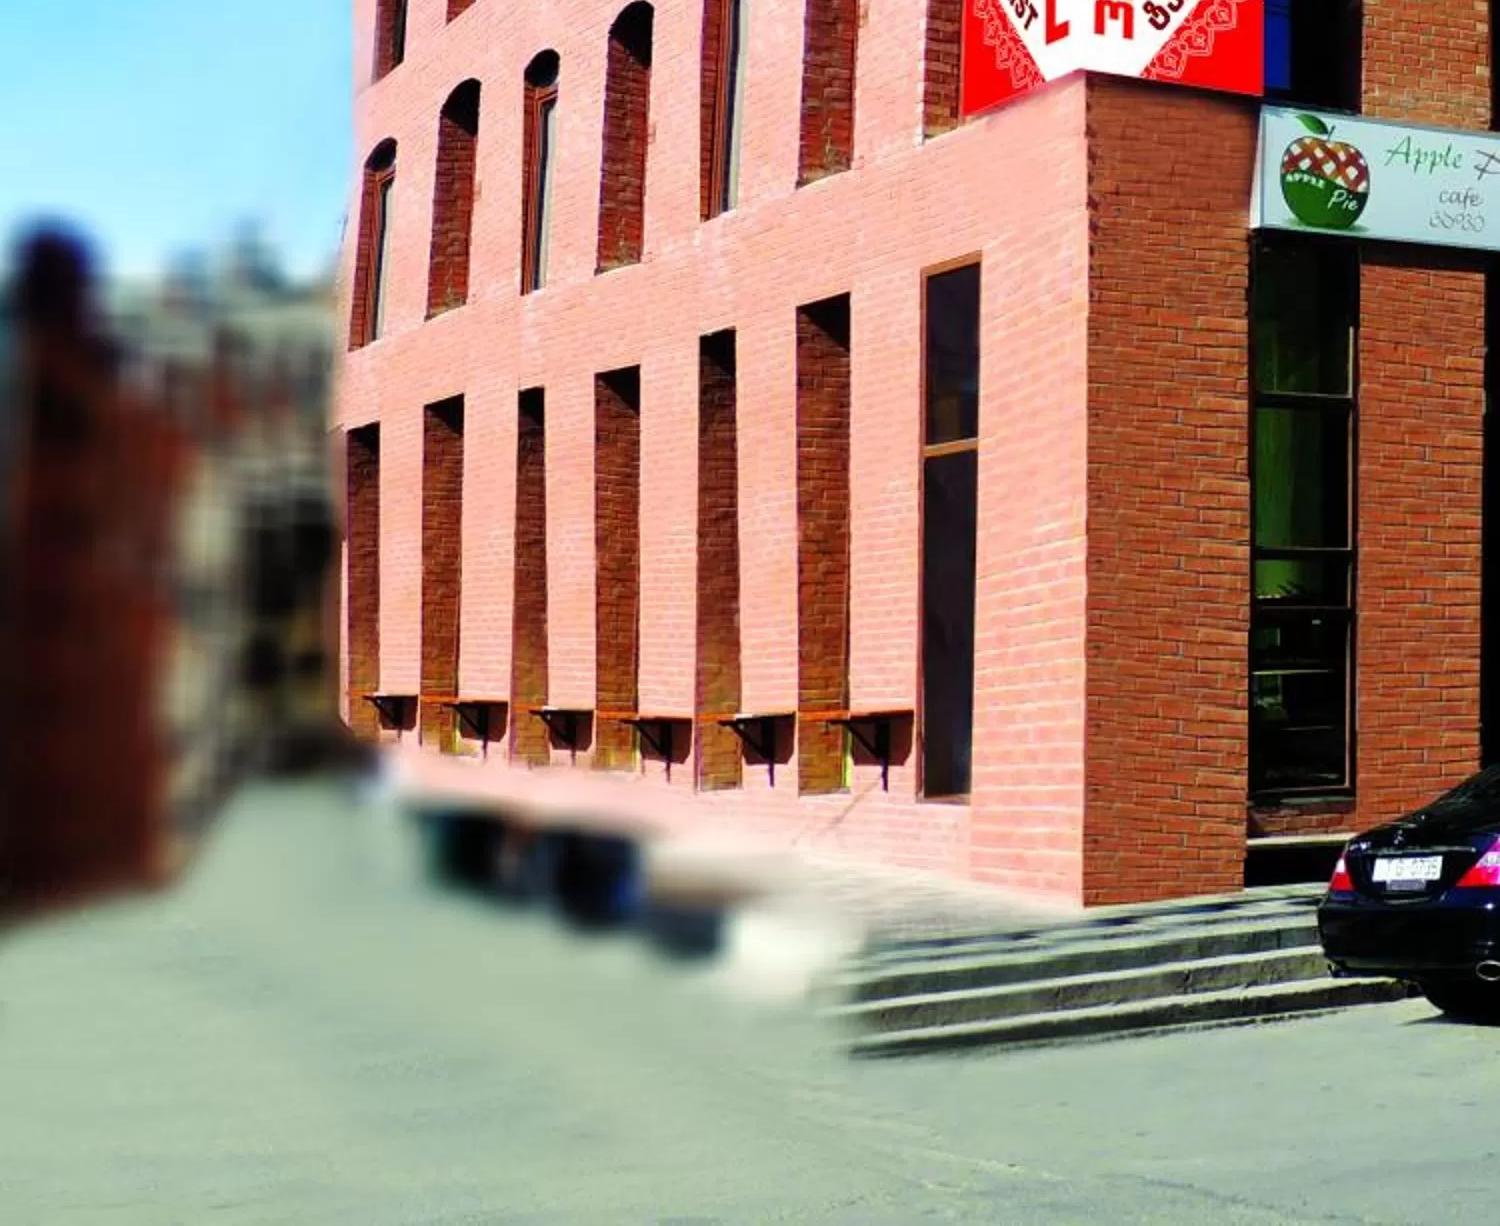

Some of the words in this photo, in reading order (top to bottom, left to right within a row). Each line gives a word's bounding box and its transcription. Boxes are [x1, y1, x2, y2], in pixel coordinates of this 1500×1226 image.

[1384, 135, 1463, 174] Apple
[1327, 189, 1359, 211] Pie
[1439, 186, 1484, 209] cafe
